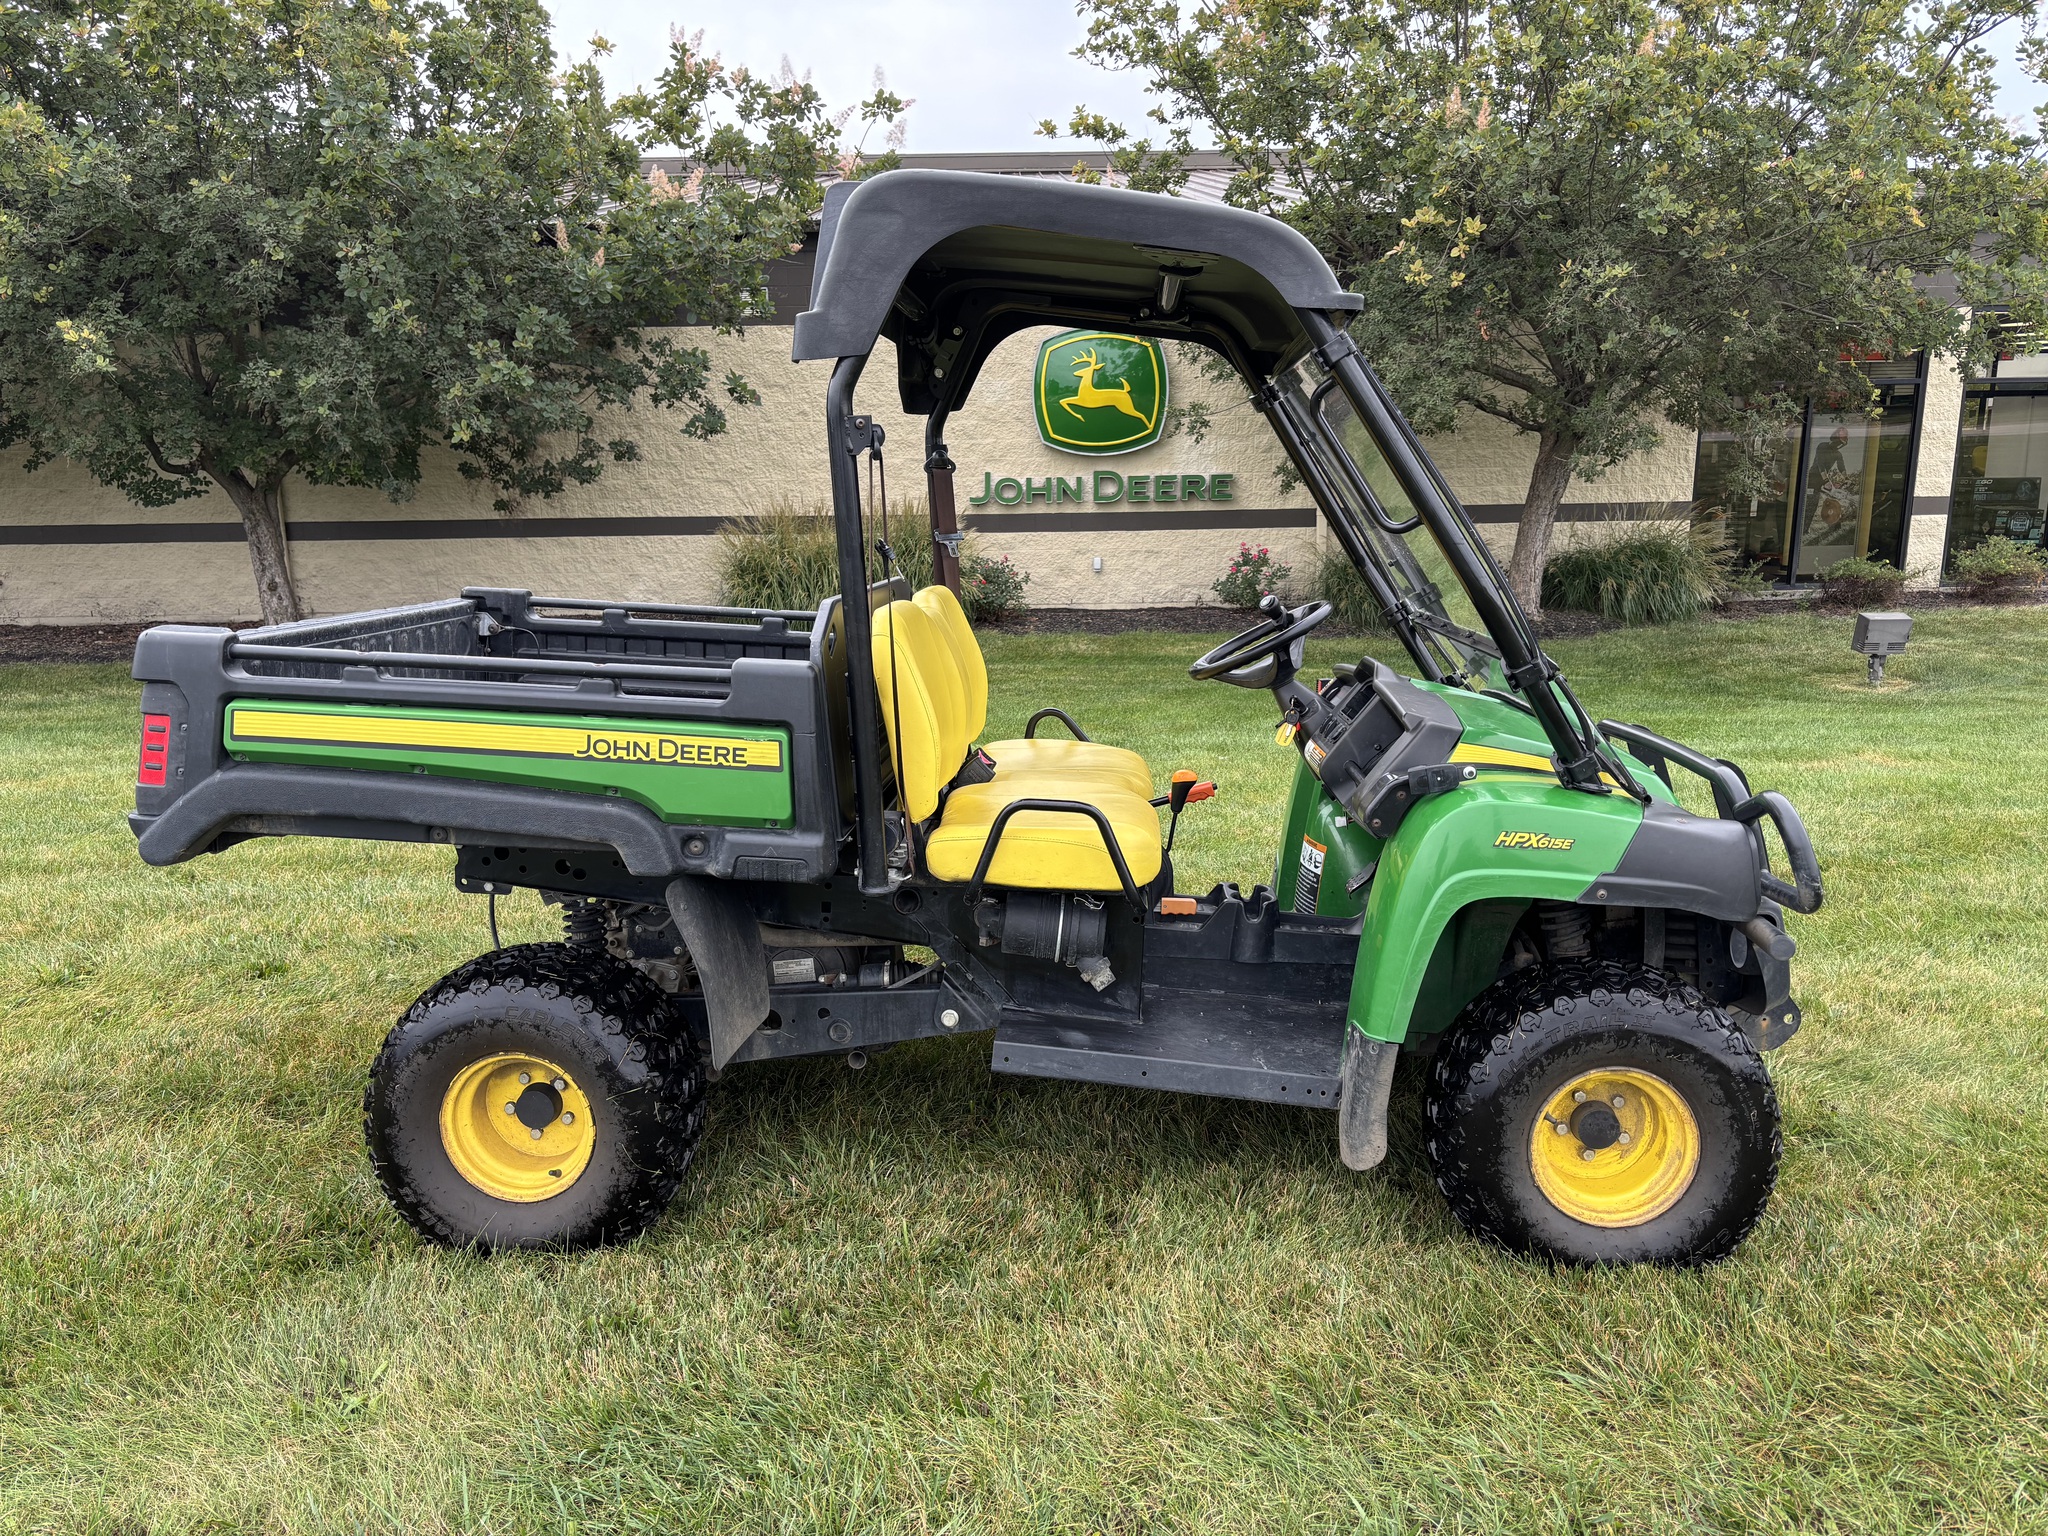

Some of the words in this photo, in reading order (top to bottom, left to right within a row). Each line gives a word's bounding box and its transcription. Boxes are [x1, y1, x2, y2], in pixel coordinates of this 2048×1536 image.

[969, 471, 1083, 506] JOHN
[1093, 470, 1234, 504] DEERE
[576, 734, 650, 758] JOHN
[658, 738, 748, 764] DEERE
[1493, 831, 1575, 850] HPX615E
[504, 1006, 608, 1066] CARLSTAR
[1497, 1046, 1540, 1089] ALL
[1545, 1013, 1625, 1045] TRAIL
